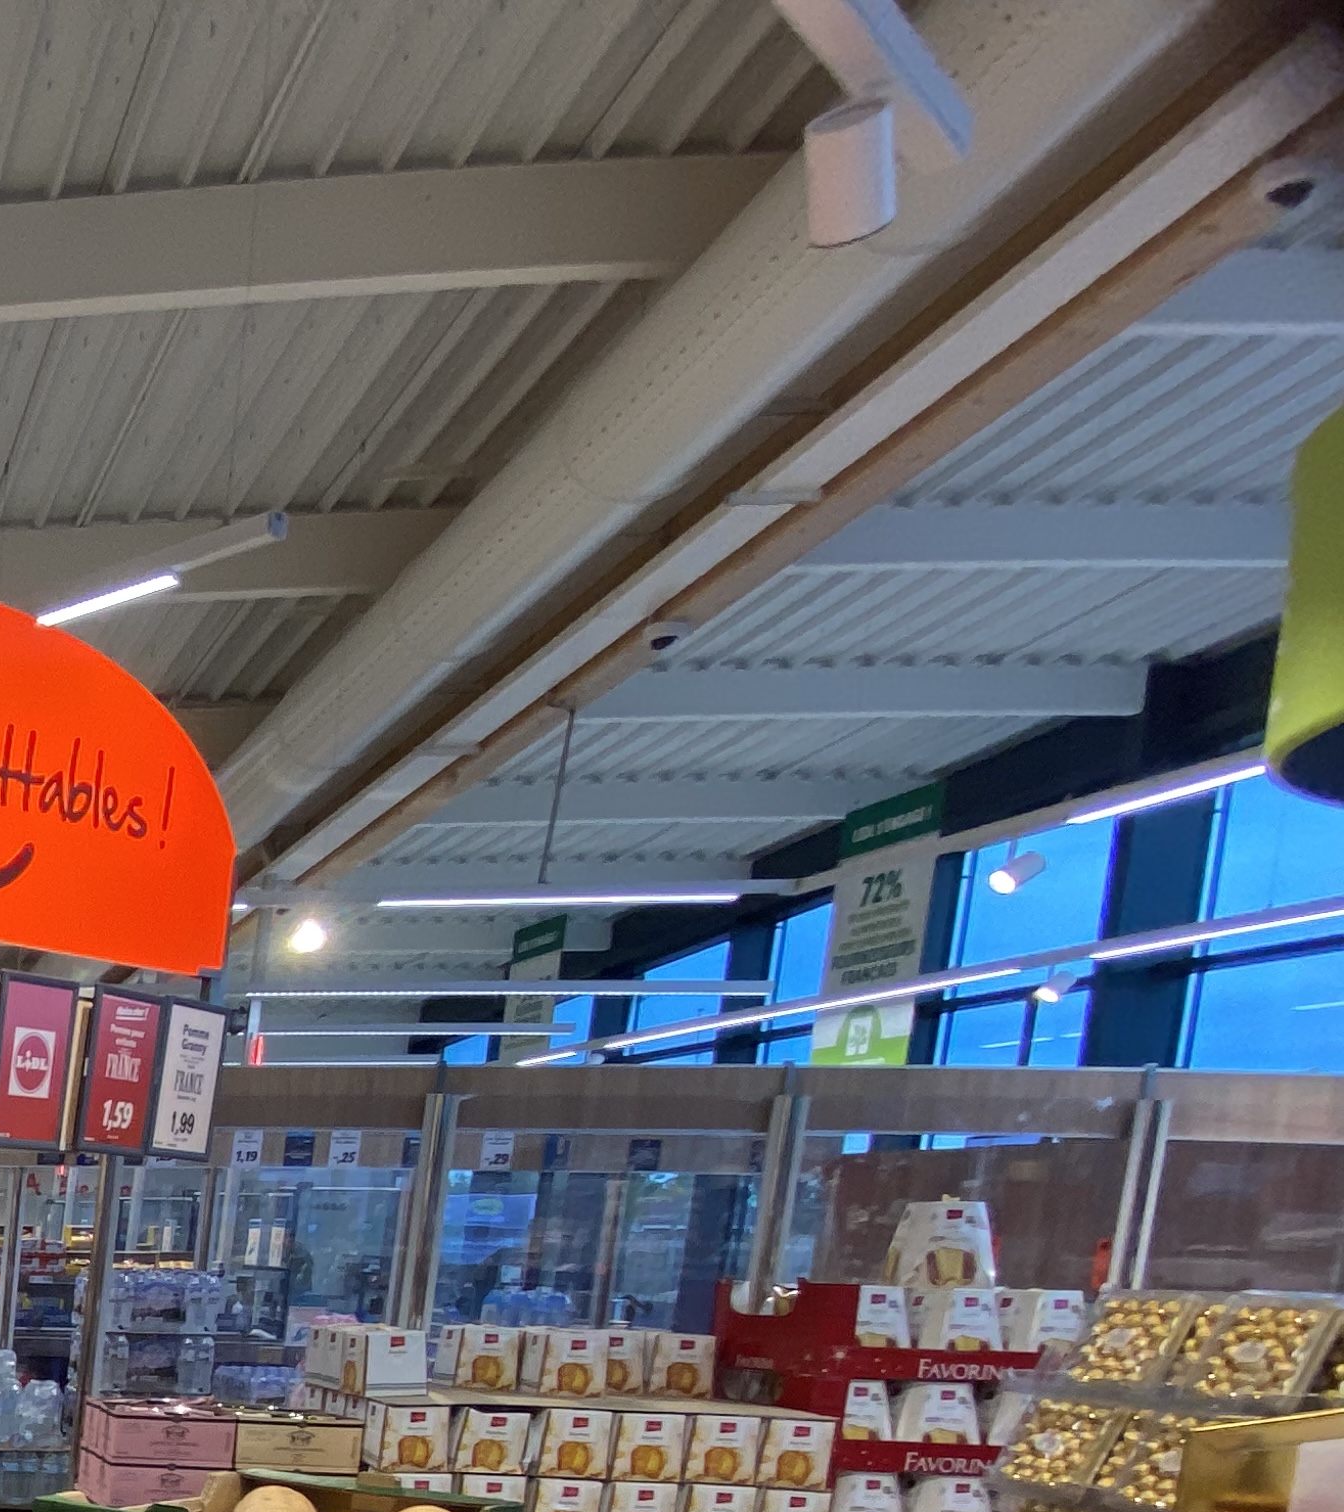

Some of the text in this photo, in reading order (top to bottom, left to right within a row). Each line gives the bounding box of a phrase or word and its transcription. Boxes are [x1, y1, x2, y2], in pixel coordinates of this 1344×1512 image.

[159, 765, 176, 850] !
[105, 1052, 142, 1083] FRANCE
[173, 1069, 204, 1095] FRANCE
[102, 1099, 134, 1131] 1,59
[171, 1111, 196, 1136] 1,99
[235, 1149, 258, 1164] 1,19
[917, 1357, 1006, 1382] FAVORIN
[904, 1450, 994, 1475] FAVORIN
